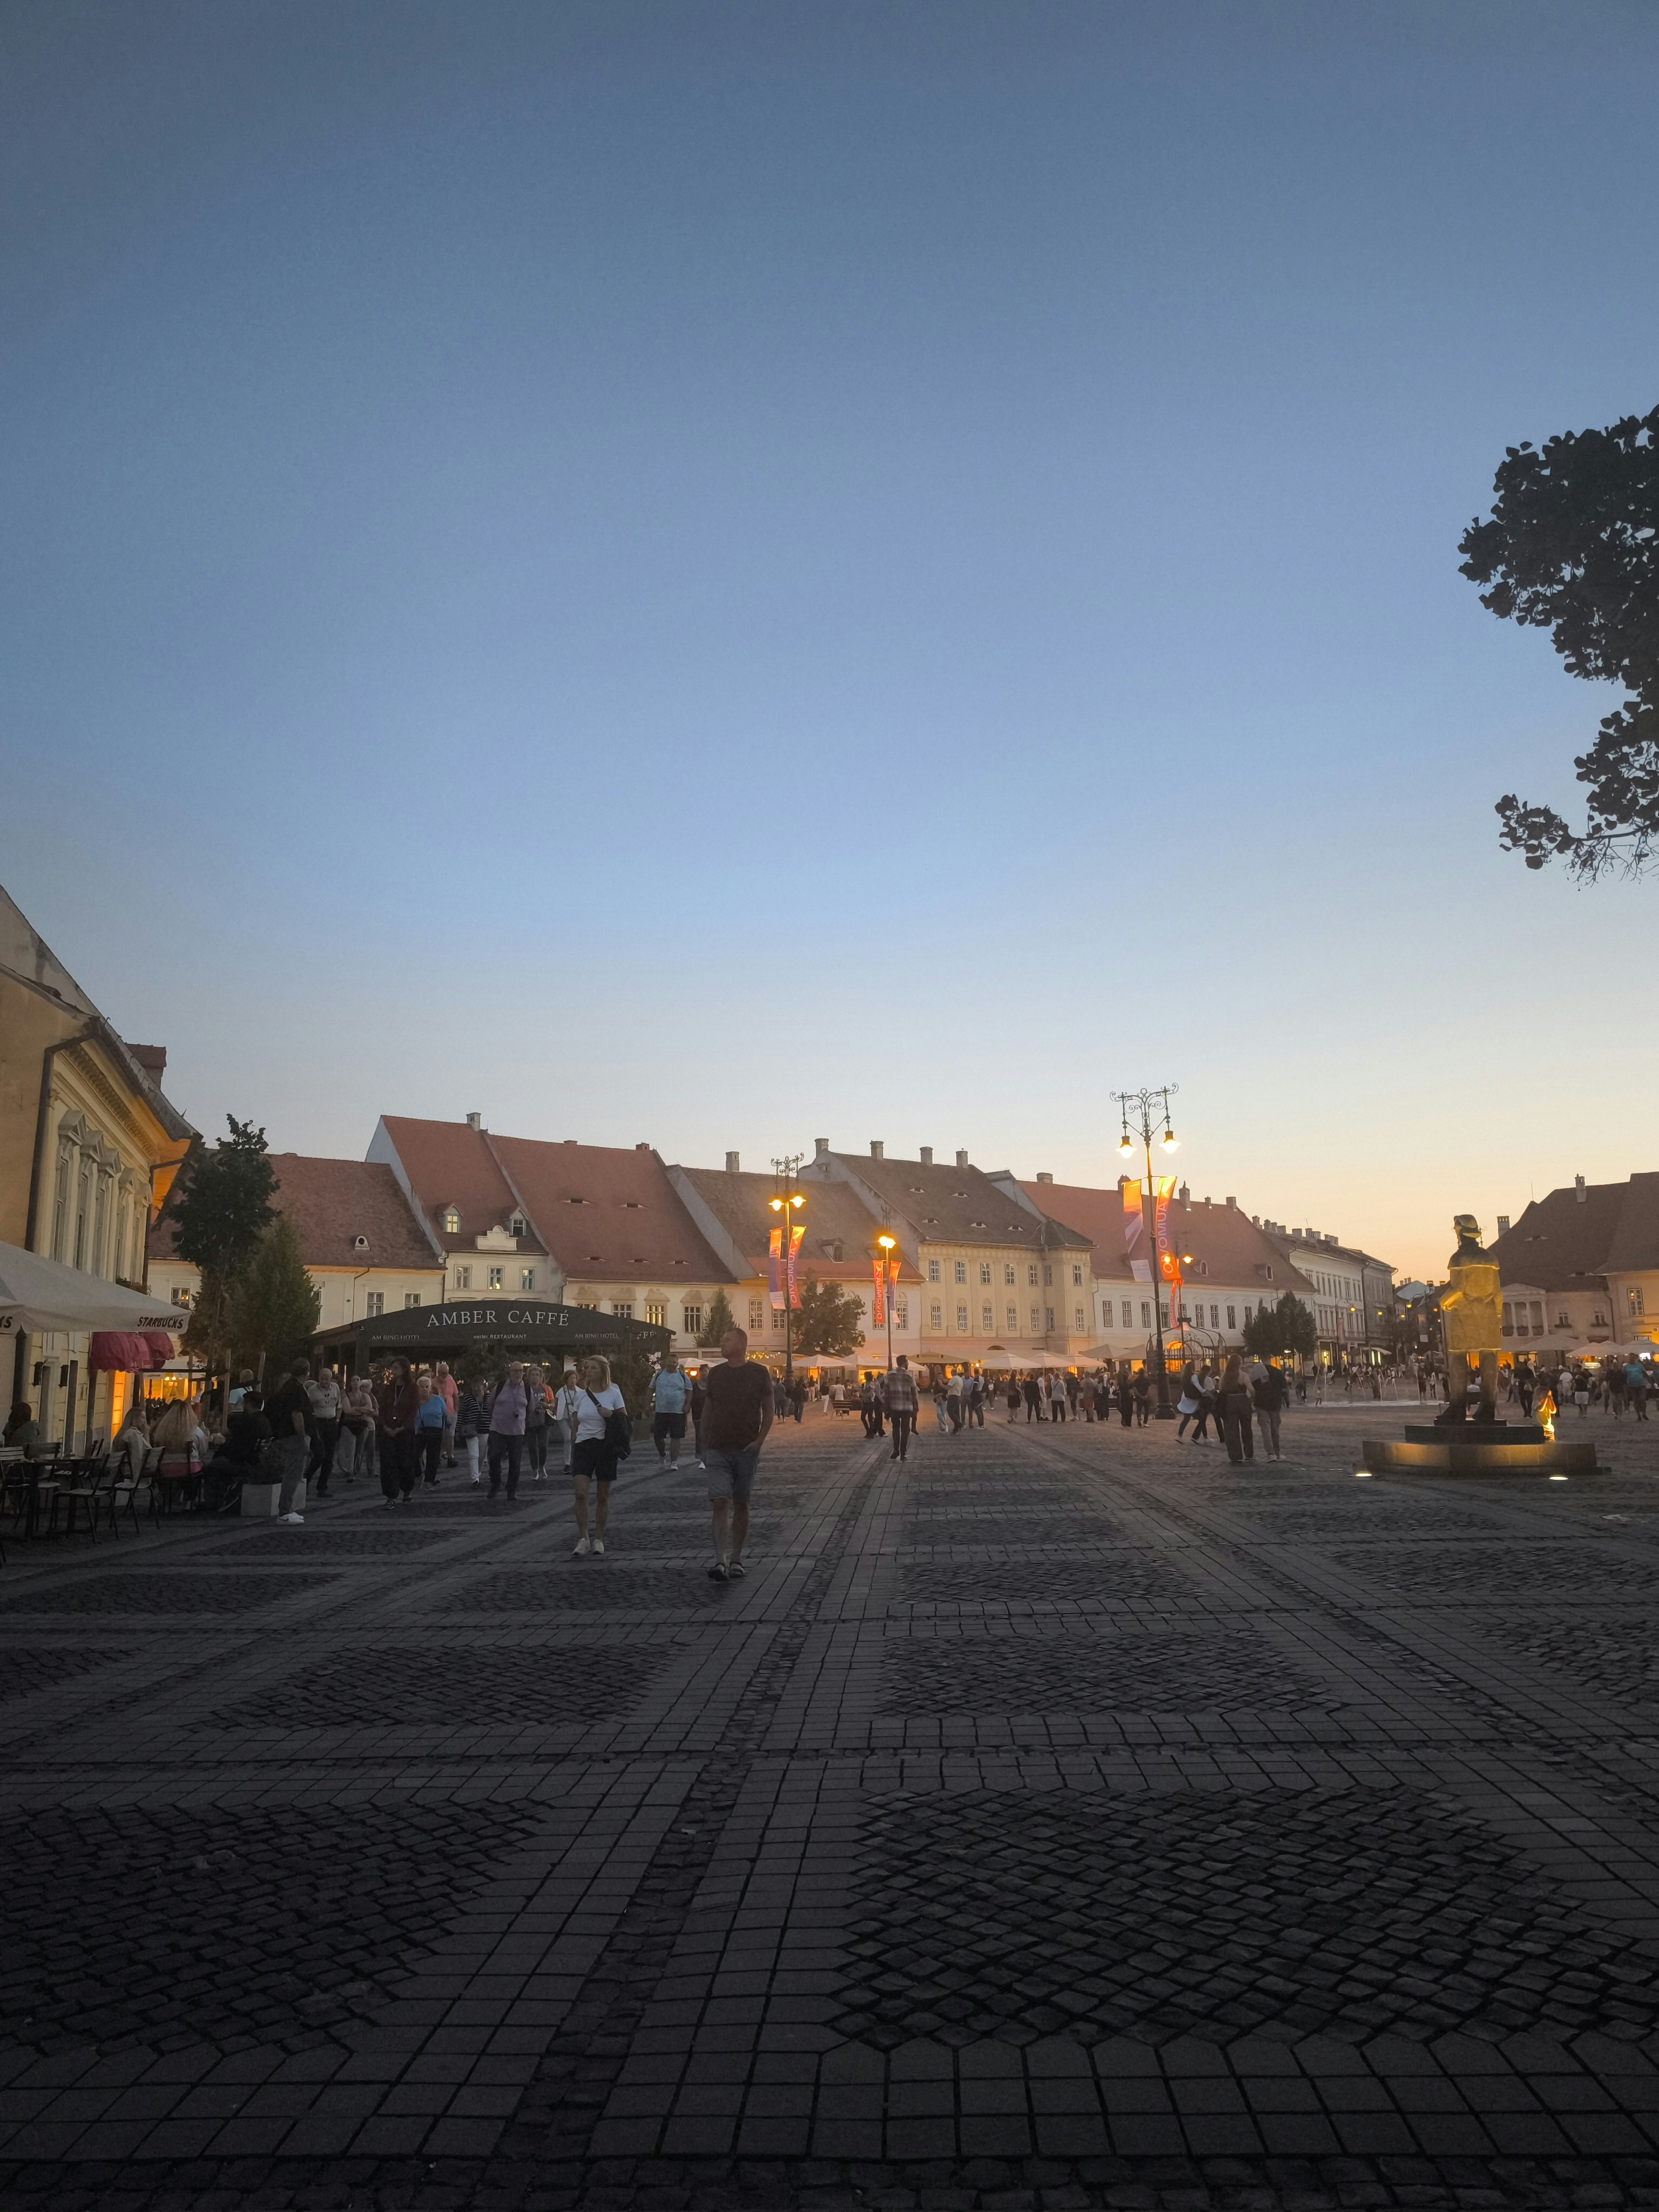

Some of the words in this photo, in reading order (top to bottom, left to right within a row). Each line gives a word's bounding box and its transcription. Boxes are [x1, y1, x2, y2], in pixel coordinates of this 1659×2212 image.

[137, 1317, 184, 1329] STARBUCKS
[427, 1310, 497, 1327] AMBER
[508, 1310, 569, 1326] CAFFÉ
